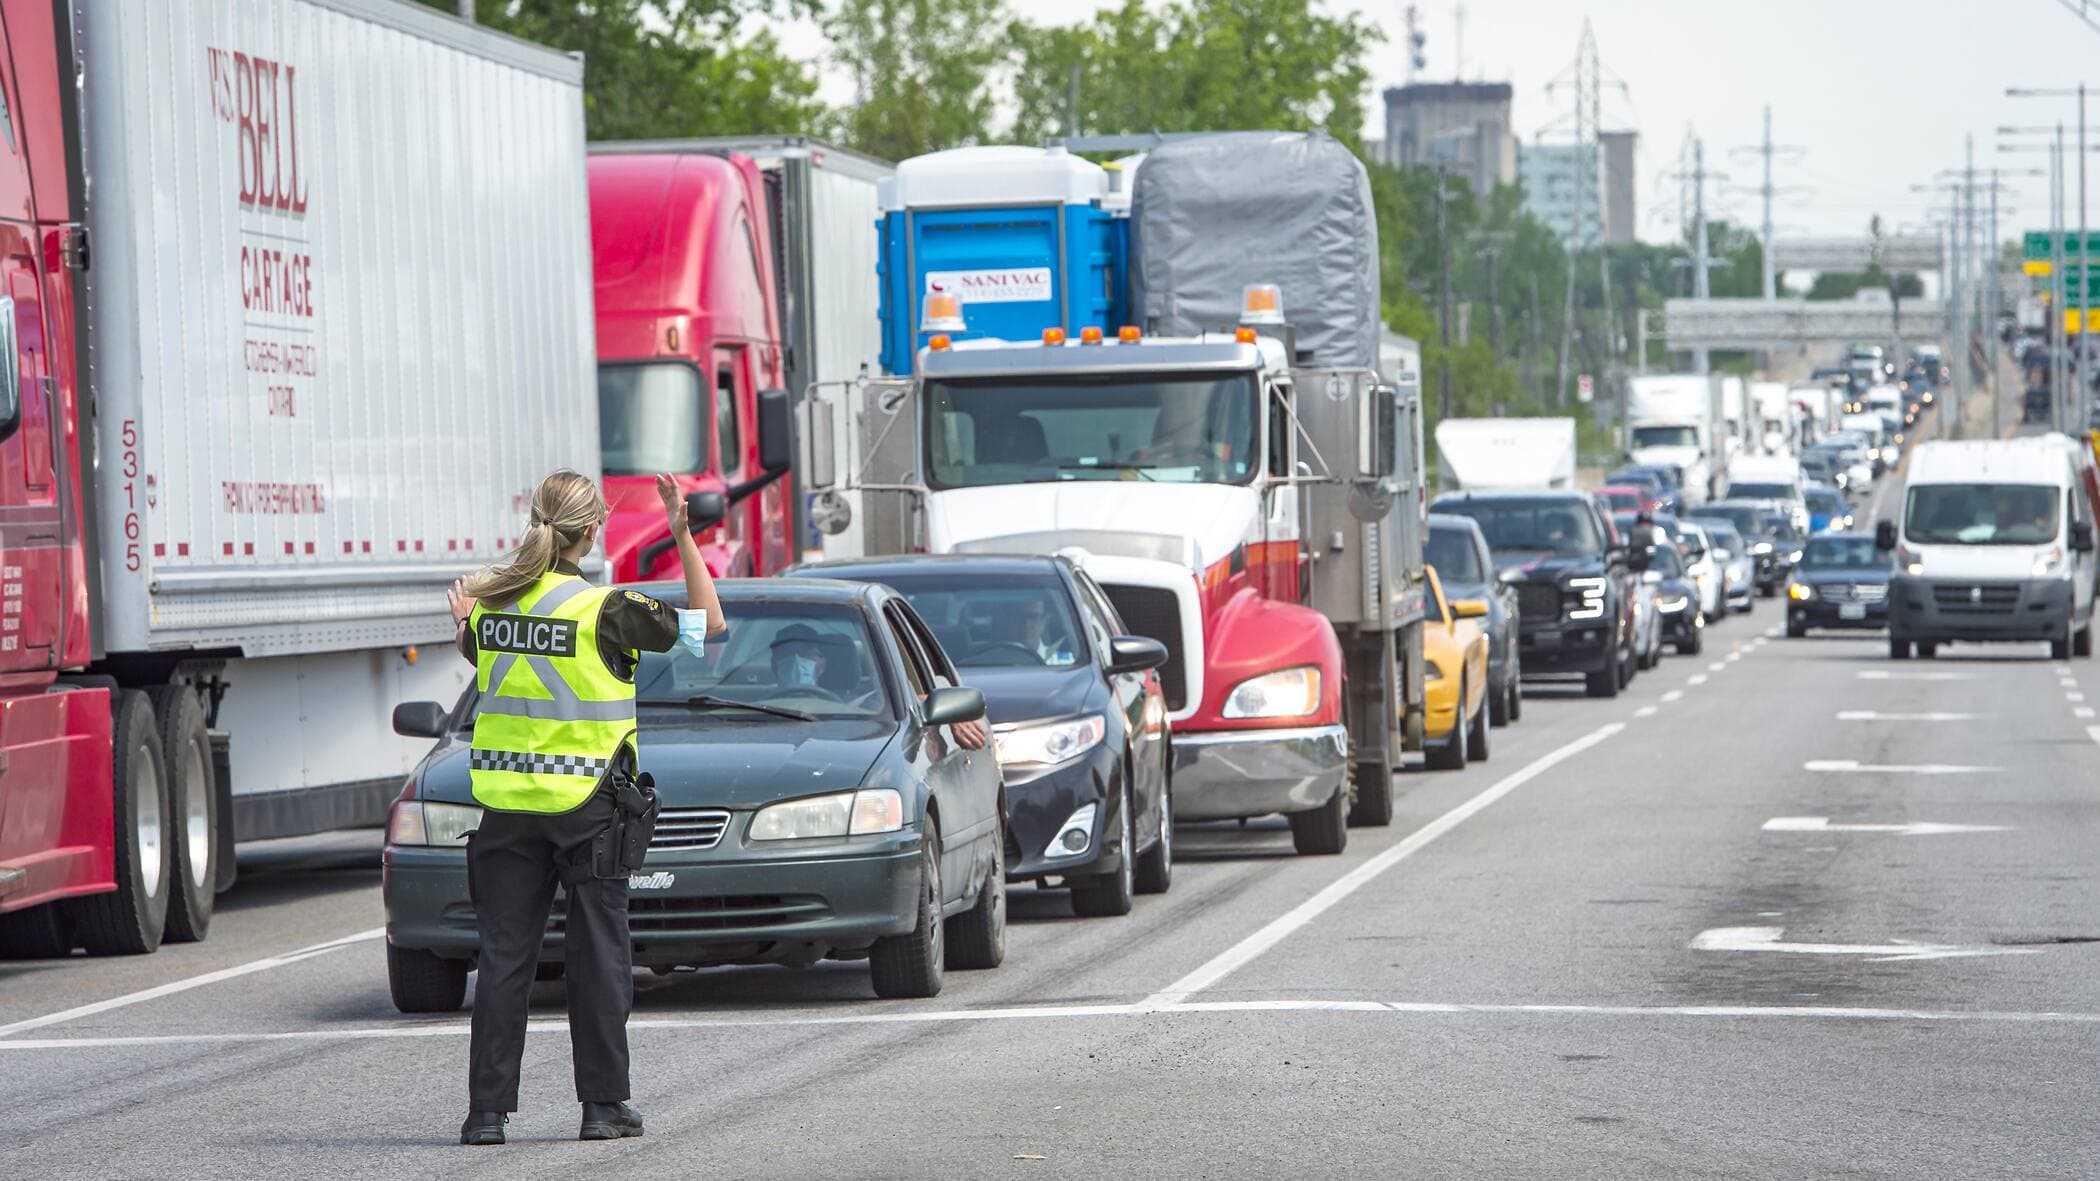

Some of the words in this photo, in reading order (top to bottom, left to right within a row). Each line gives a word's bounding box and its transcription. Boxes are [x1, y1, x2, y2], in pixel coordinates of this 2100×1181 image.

[234, 51, 308, 214] BELL
[241, 246, 313, 317] CARTAGE
[482, 619, 568, 652] POLICE
